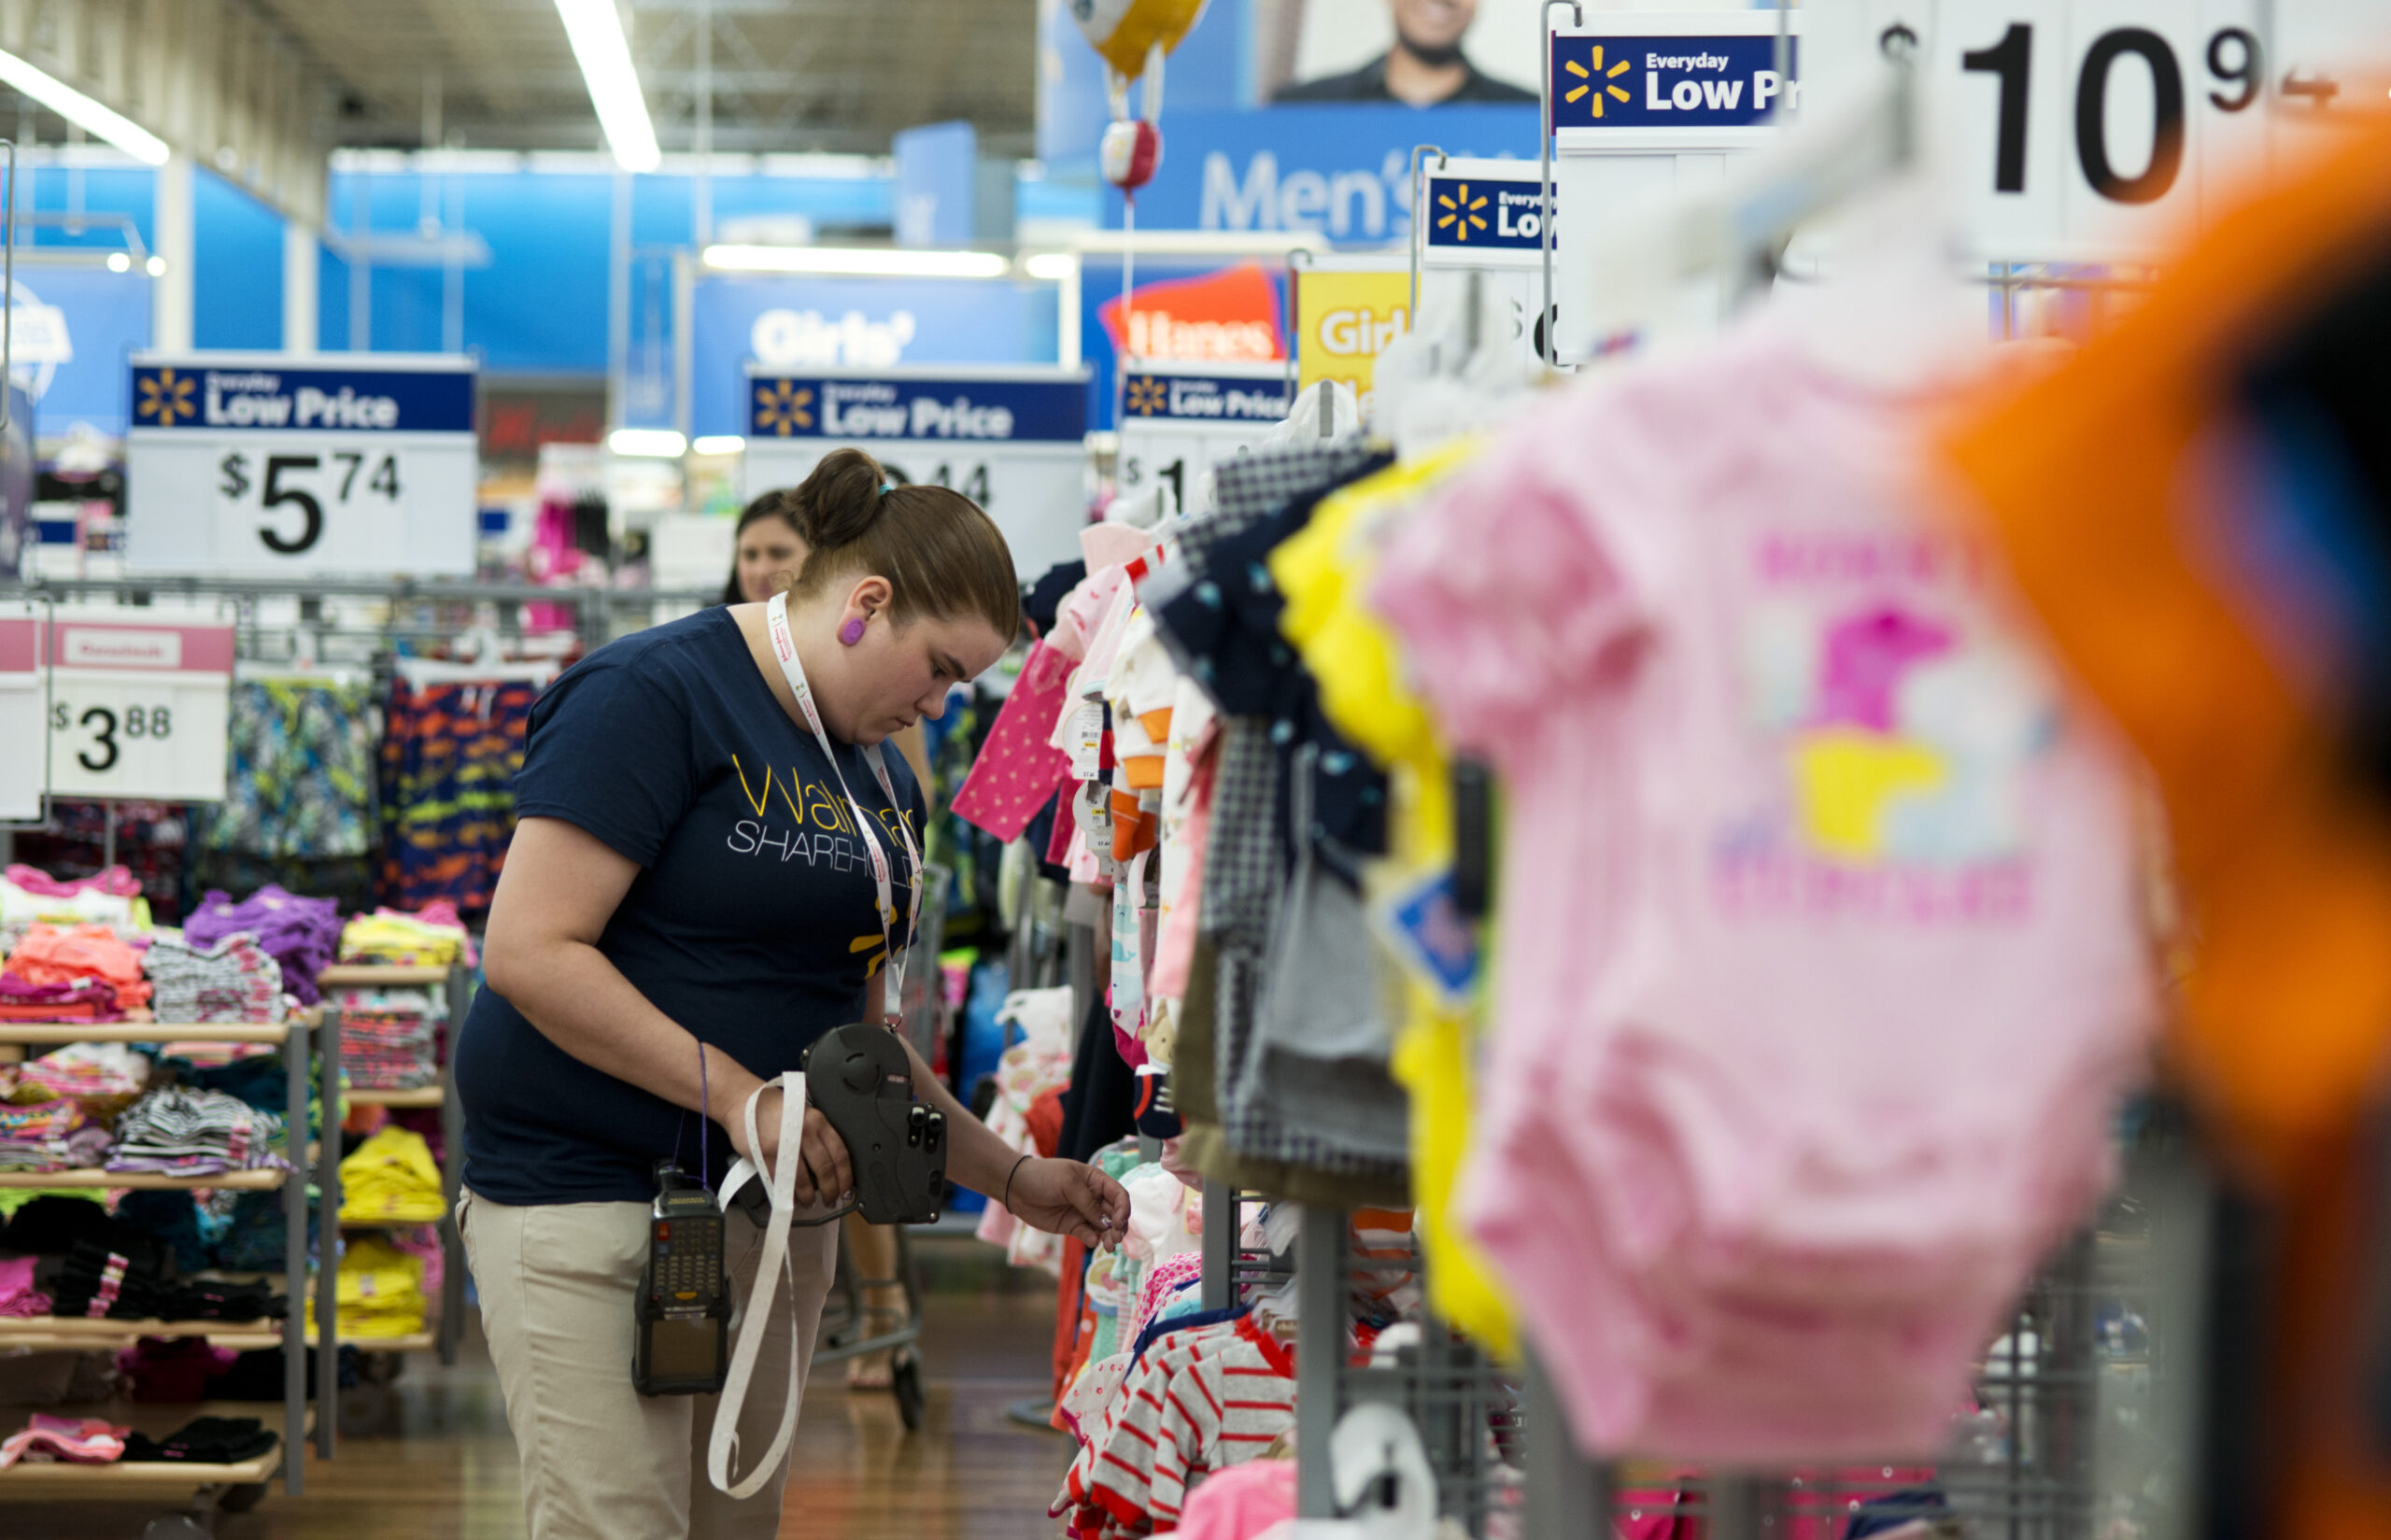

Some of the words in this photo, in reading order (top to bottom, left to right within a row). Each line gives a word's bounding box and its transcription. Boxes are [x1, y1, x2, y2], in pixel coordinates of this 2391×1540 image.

[1646, 52, 1729, 72] Everyday
[1646, 70, 1744, 110] Low
[205, 385, 292, 426] Low
[294, 386, 399, 428] Price
[821, 394, 909, 437] Low
[910, 396, 1014, 438] Price
